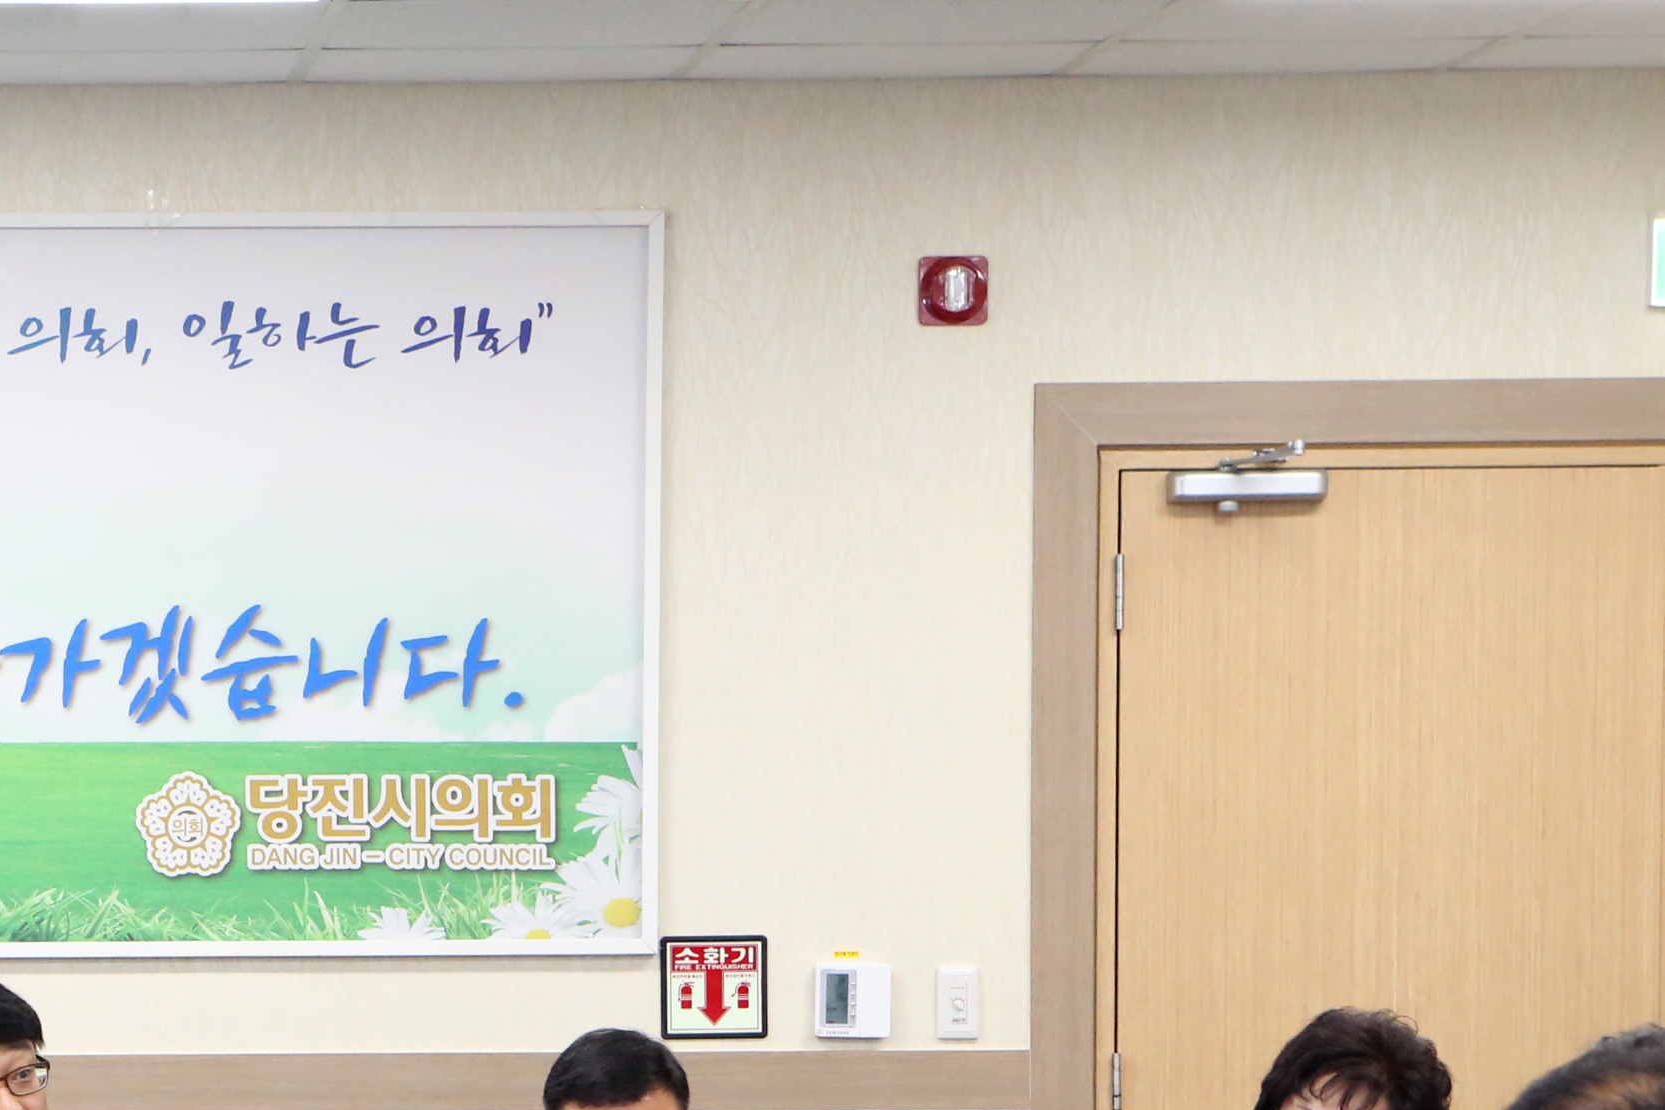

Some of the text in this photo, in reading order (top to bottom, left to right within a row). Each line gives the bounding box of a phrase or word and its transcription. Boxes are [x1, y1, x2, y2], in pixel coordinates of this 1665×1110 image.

[7, 306, 152, 365] 의회,
[183, 301, 381, 369] 일하는
[247, 775, 554, 841] 당진시의회
[171, 818, 205, 837] 의회
[251, 848, 315, 867] DANG
[323, 848, 357, 867] JIN
[390, 848, 441, 867] CITY
[449, 848, 552, 867] COUNCIL
[674, 946, 754, 964] 소화기
